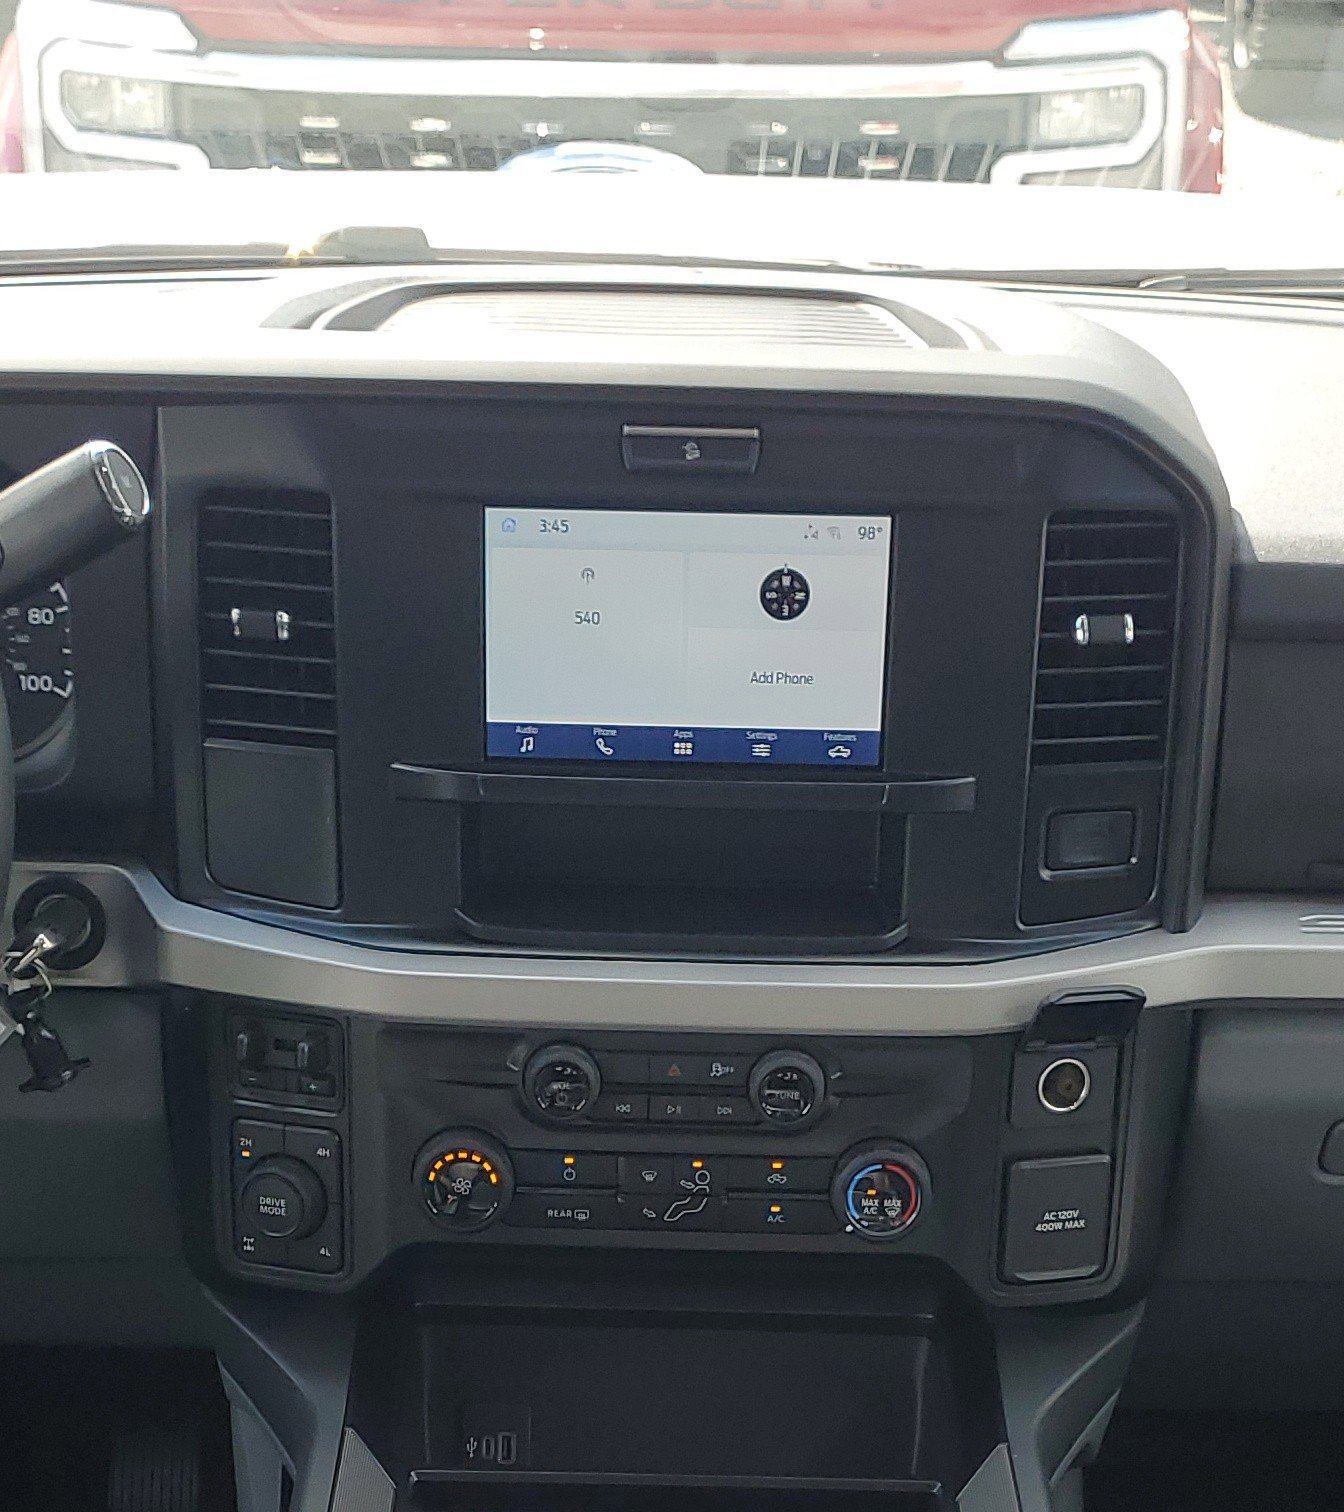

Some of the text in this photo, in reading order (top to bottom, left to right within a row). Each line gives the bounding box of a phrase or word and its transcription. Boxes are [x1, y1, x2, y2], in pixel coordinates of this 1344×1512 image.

[539, 519, 570, 533] 3:45
[27, 607, 55, 625] 80
[574, 611, 601, 625] 540
[19, 674, 53, 692] 100
[750, 671, 814, 685] Add Phone
[515, 725, 539, 734] Audio
[592, 727, 618, 736] Phone
[673, 729, 694, 739] Apps
[773, 1090, 801, 1101] TUNE
[239, 1137, 252, 1147] 2H
[316, 1147, 331, 1158] 4H
[259, 1196, 287, 1207] DRIVE
[861, 1198, 879, 1207] MAX
[884, 1198, 902, 1208] MAX
[259, 1205, 287, 1217] MODE
[547, 1209, 573, 1218] REAR
[863, 1206, 878, 1215] A/C
[1043, 1209, 1080, 1220] AC 120V
[767, 1214, 786, 1223] A/C
[1035, 1218, 1086, 1232] 400W MAX
[319, 1247, 331, 1257] 4L
